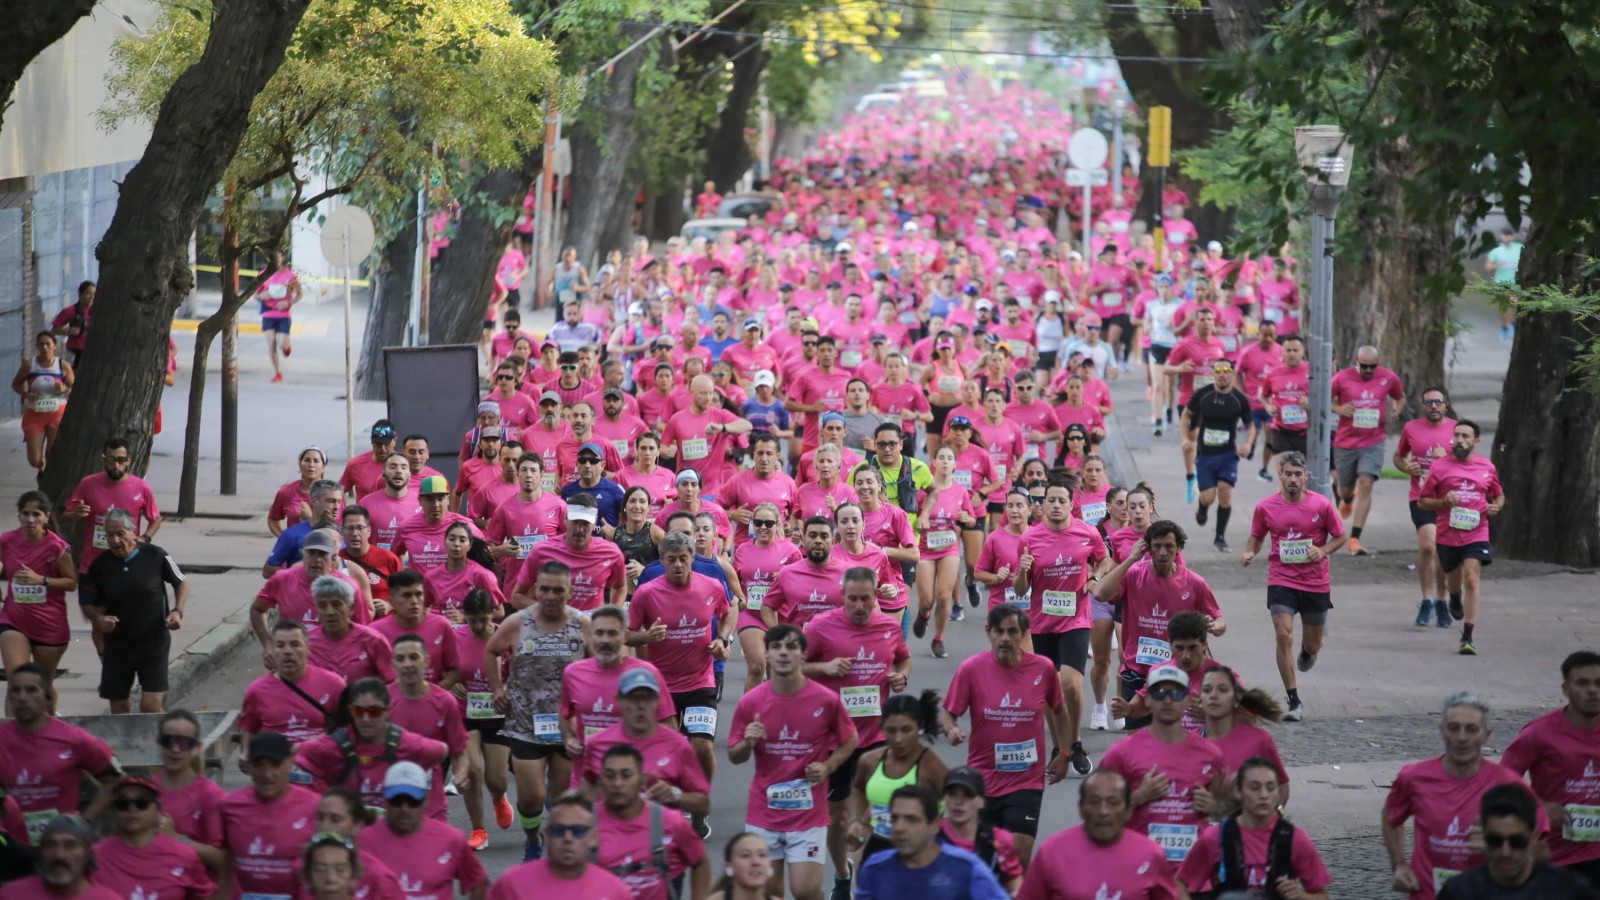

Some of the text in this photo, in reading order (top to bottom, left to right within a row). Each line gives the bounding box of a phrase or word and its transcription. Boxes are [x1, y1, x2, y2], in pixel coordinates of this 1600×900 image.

[1047, 598, 1071, 607] Y2112
[1138, 616, 1169, 625] MediaMara
[1141, 646, 1170, 658] #1470
[844, 695, 877, 706] Y2847
[687, 715, 714, 725] #1482
[541, 723, 560, 732] #11
[1001, 750, 1032, 761] #1184
[772, 788, 807, 799] #1005
[1570, 817, 1600, 829] Y304
[1155, 836, 1193, 848] #1320
